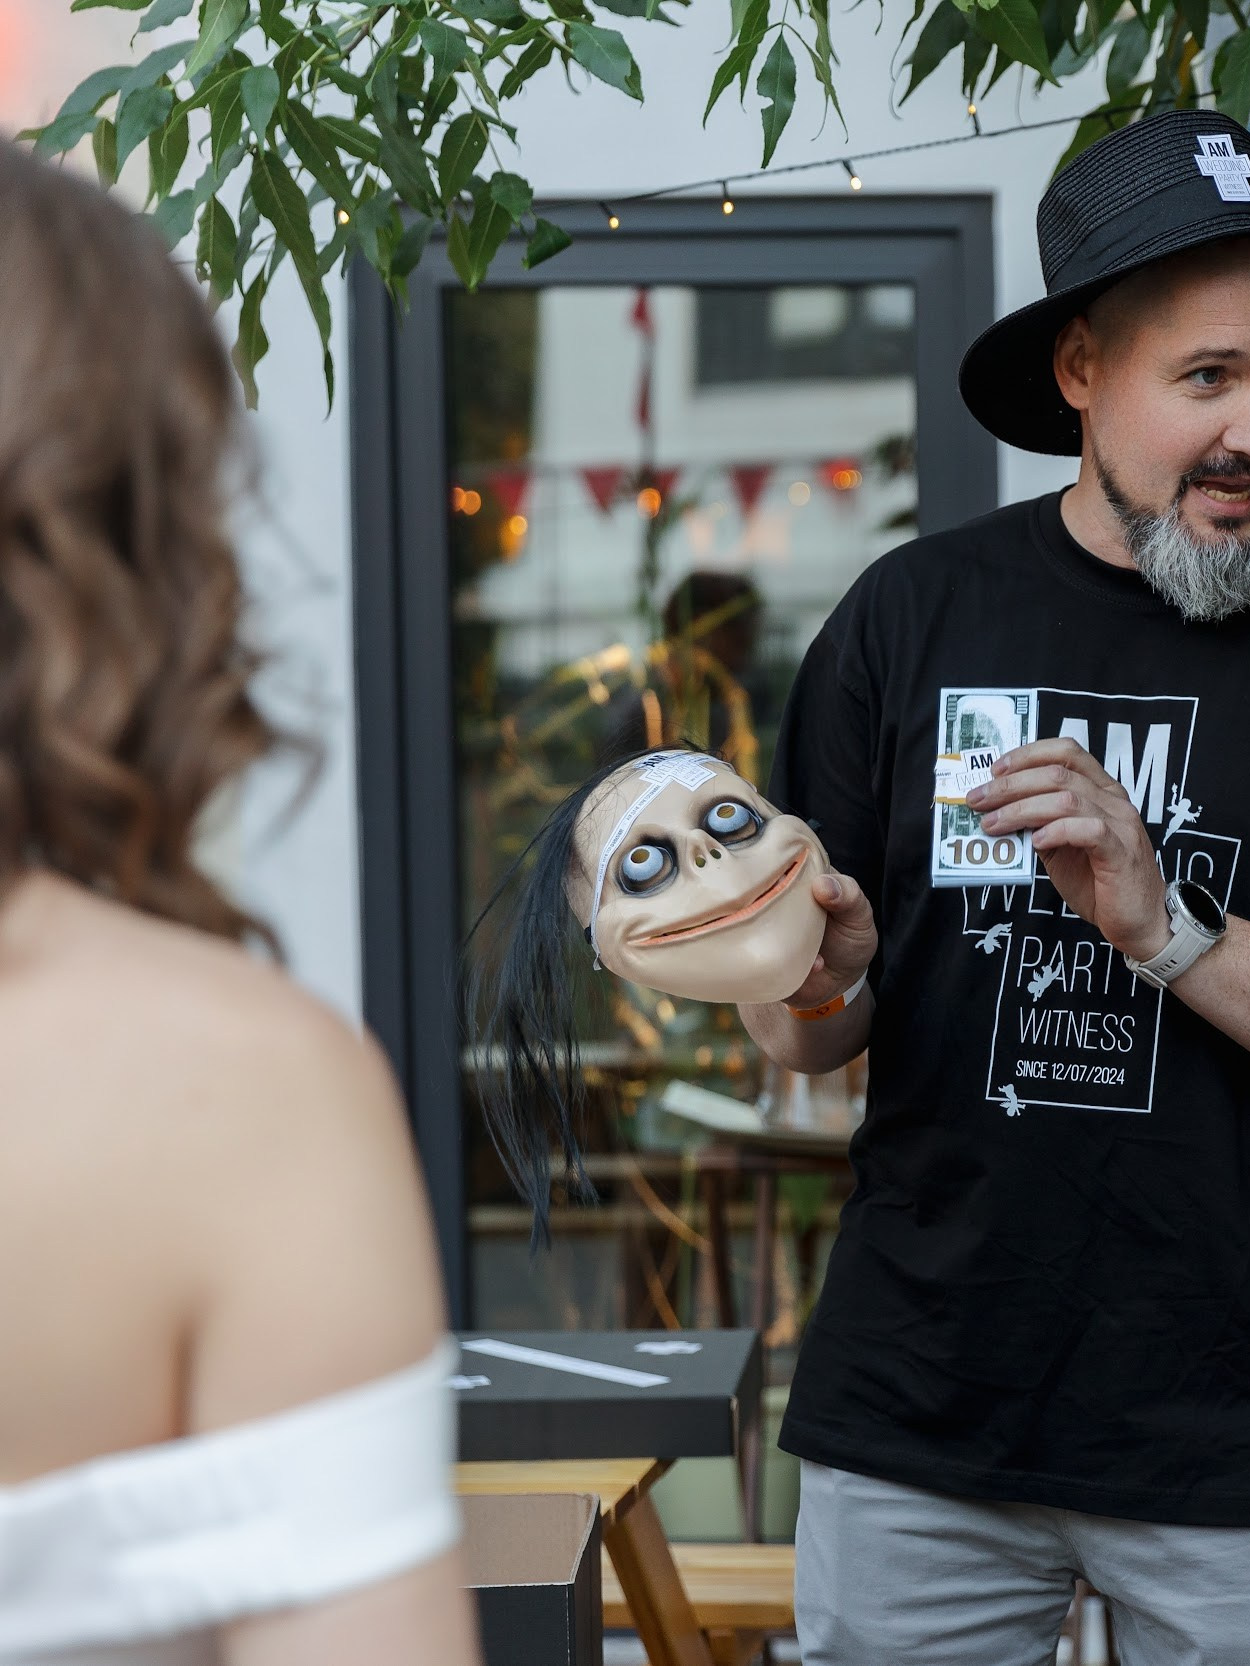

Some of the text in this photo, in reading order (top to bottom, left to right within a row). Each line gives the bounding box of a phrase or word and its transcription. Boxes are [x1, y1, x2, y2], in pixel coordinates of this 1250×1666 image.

[1207, 142, 1230, 157] AM
[1202, 160, 1246, 171] WEDDING
[642, 754, 669, 768] AM
[970, 753, 993, 770] AM
[947, 838, 1016, 865] 100
[1016, 936, 1138, 997] PART
[1019, 1006, 1136, 1053] WITNESS
[1015, 1060, 1126, 1085] SINCE 12/07/2024
